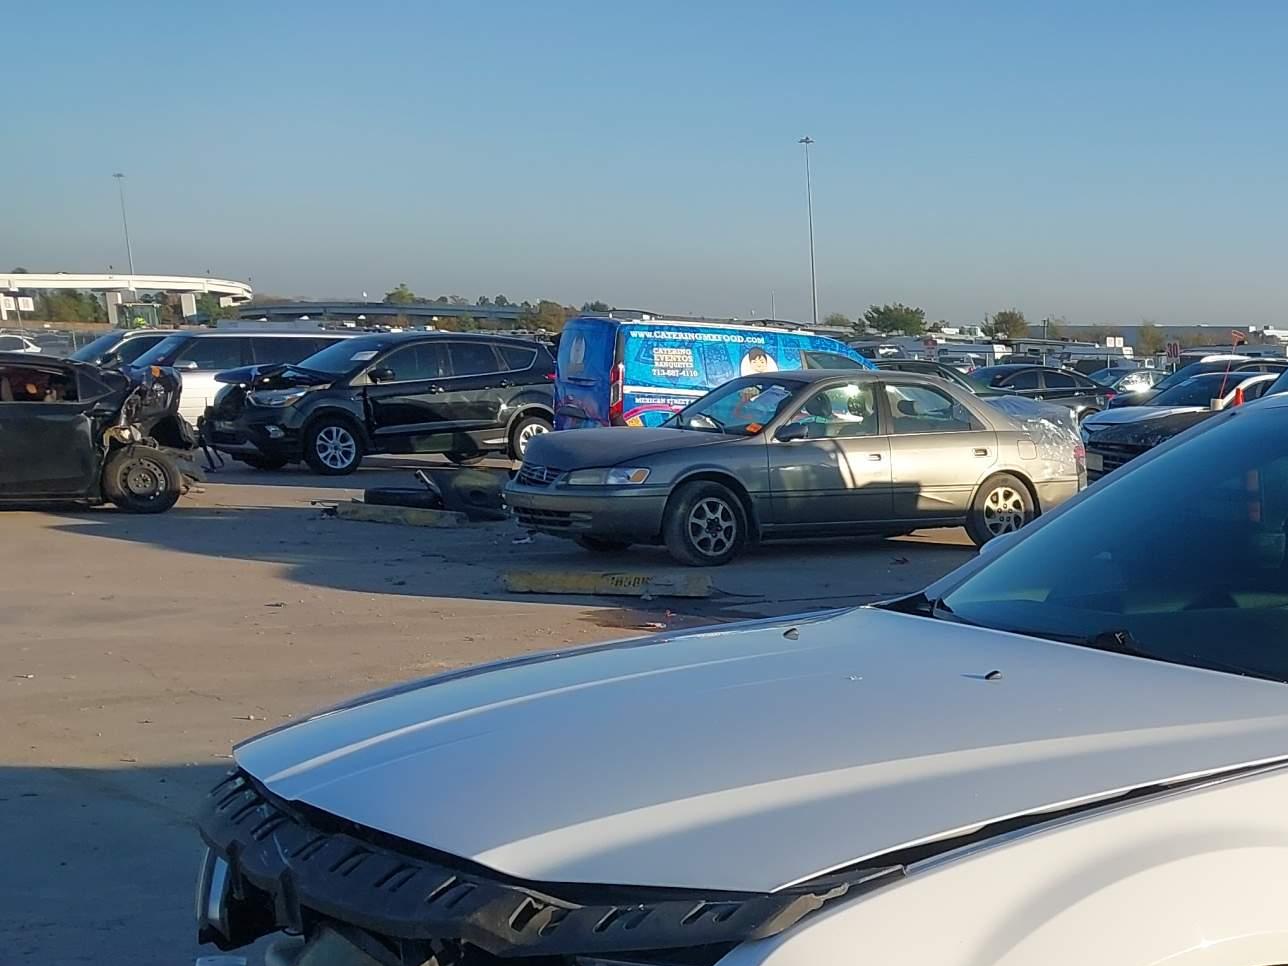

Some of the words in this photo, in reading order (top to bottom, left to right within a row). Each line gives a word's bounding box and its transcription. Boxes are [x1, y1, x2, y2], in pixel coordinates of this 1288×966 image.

[652, 347, 692, 356] CATERING
[1167, 342, 1179, 359] 30
[653, 354, 694, 362] EVENTOS
